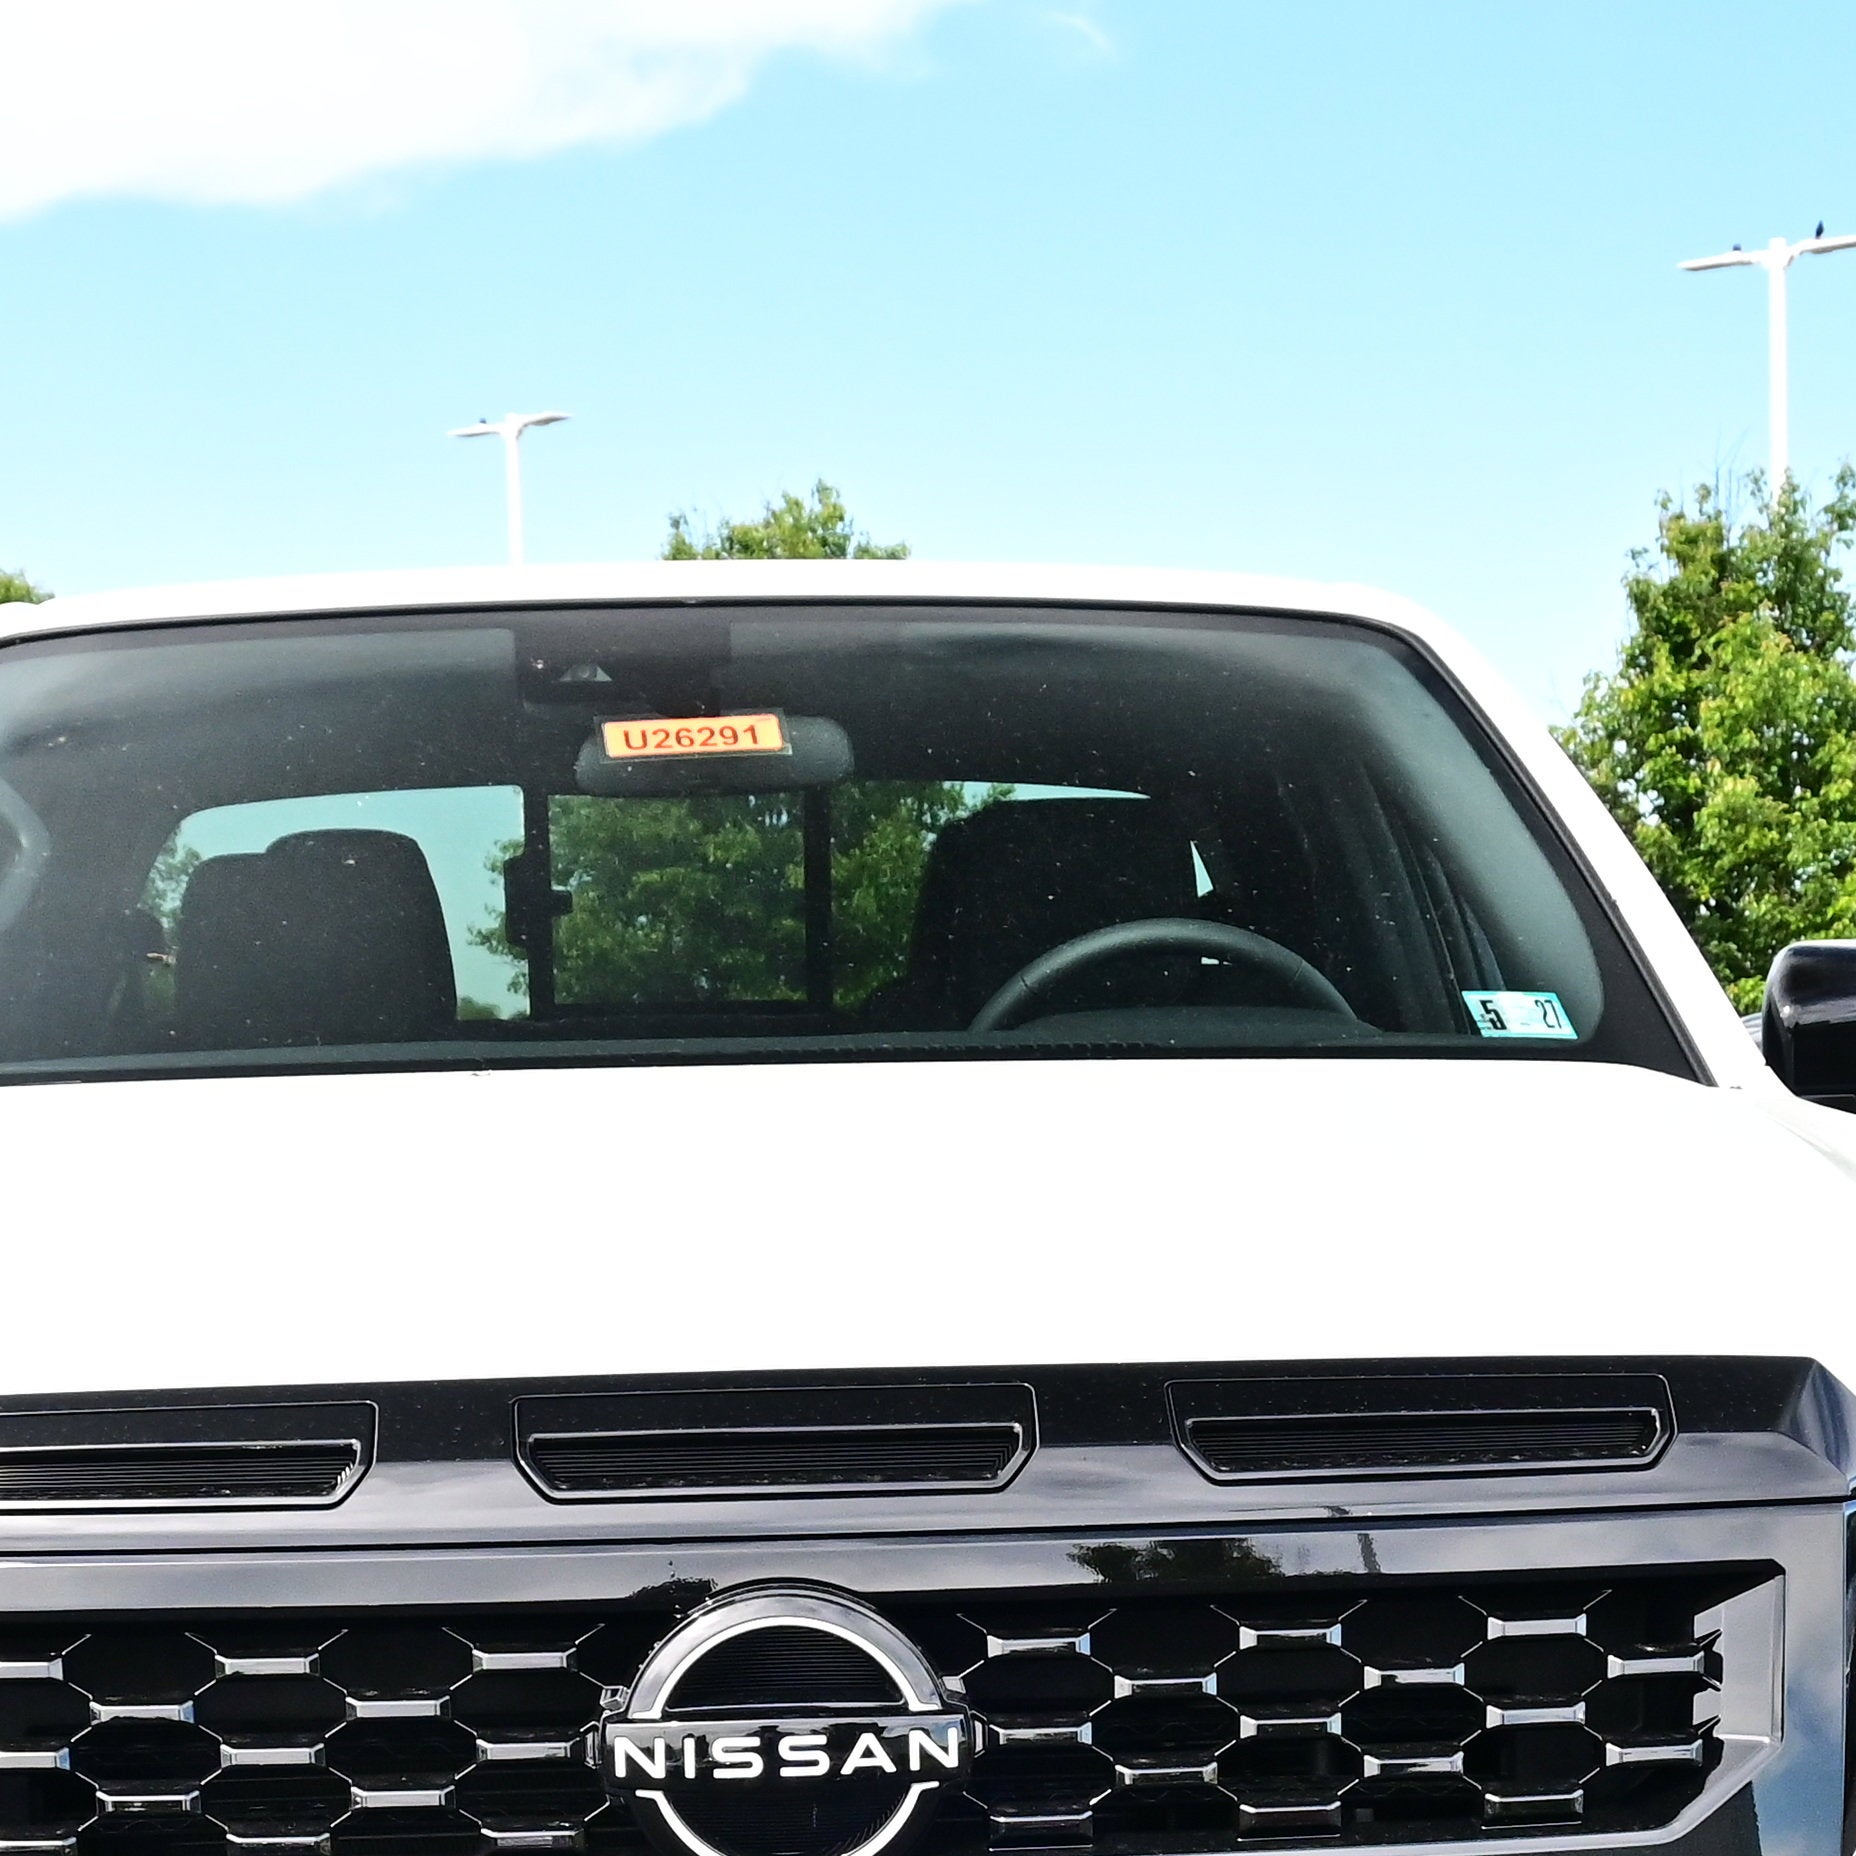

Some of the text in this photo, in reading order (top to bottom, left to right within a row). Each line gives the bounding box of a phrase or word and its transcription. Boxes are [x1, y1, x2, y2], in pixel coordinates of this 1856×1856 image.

[623, 724, 759, 751] U26291
[1478, 999, 1507, 1030] 5
[613, 1726, 960, 1780] NISSAN
